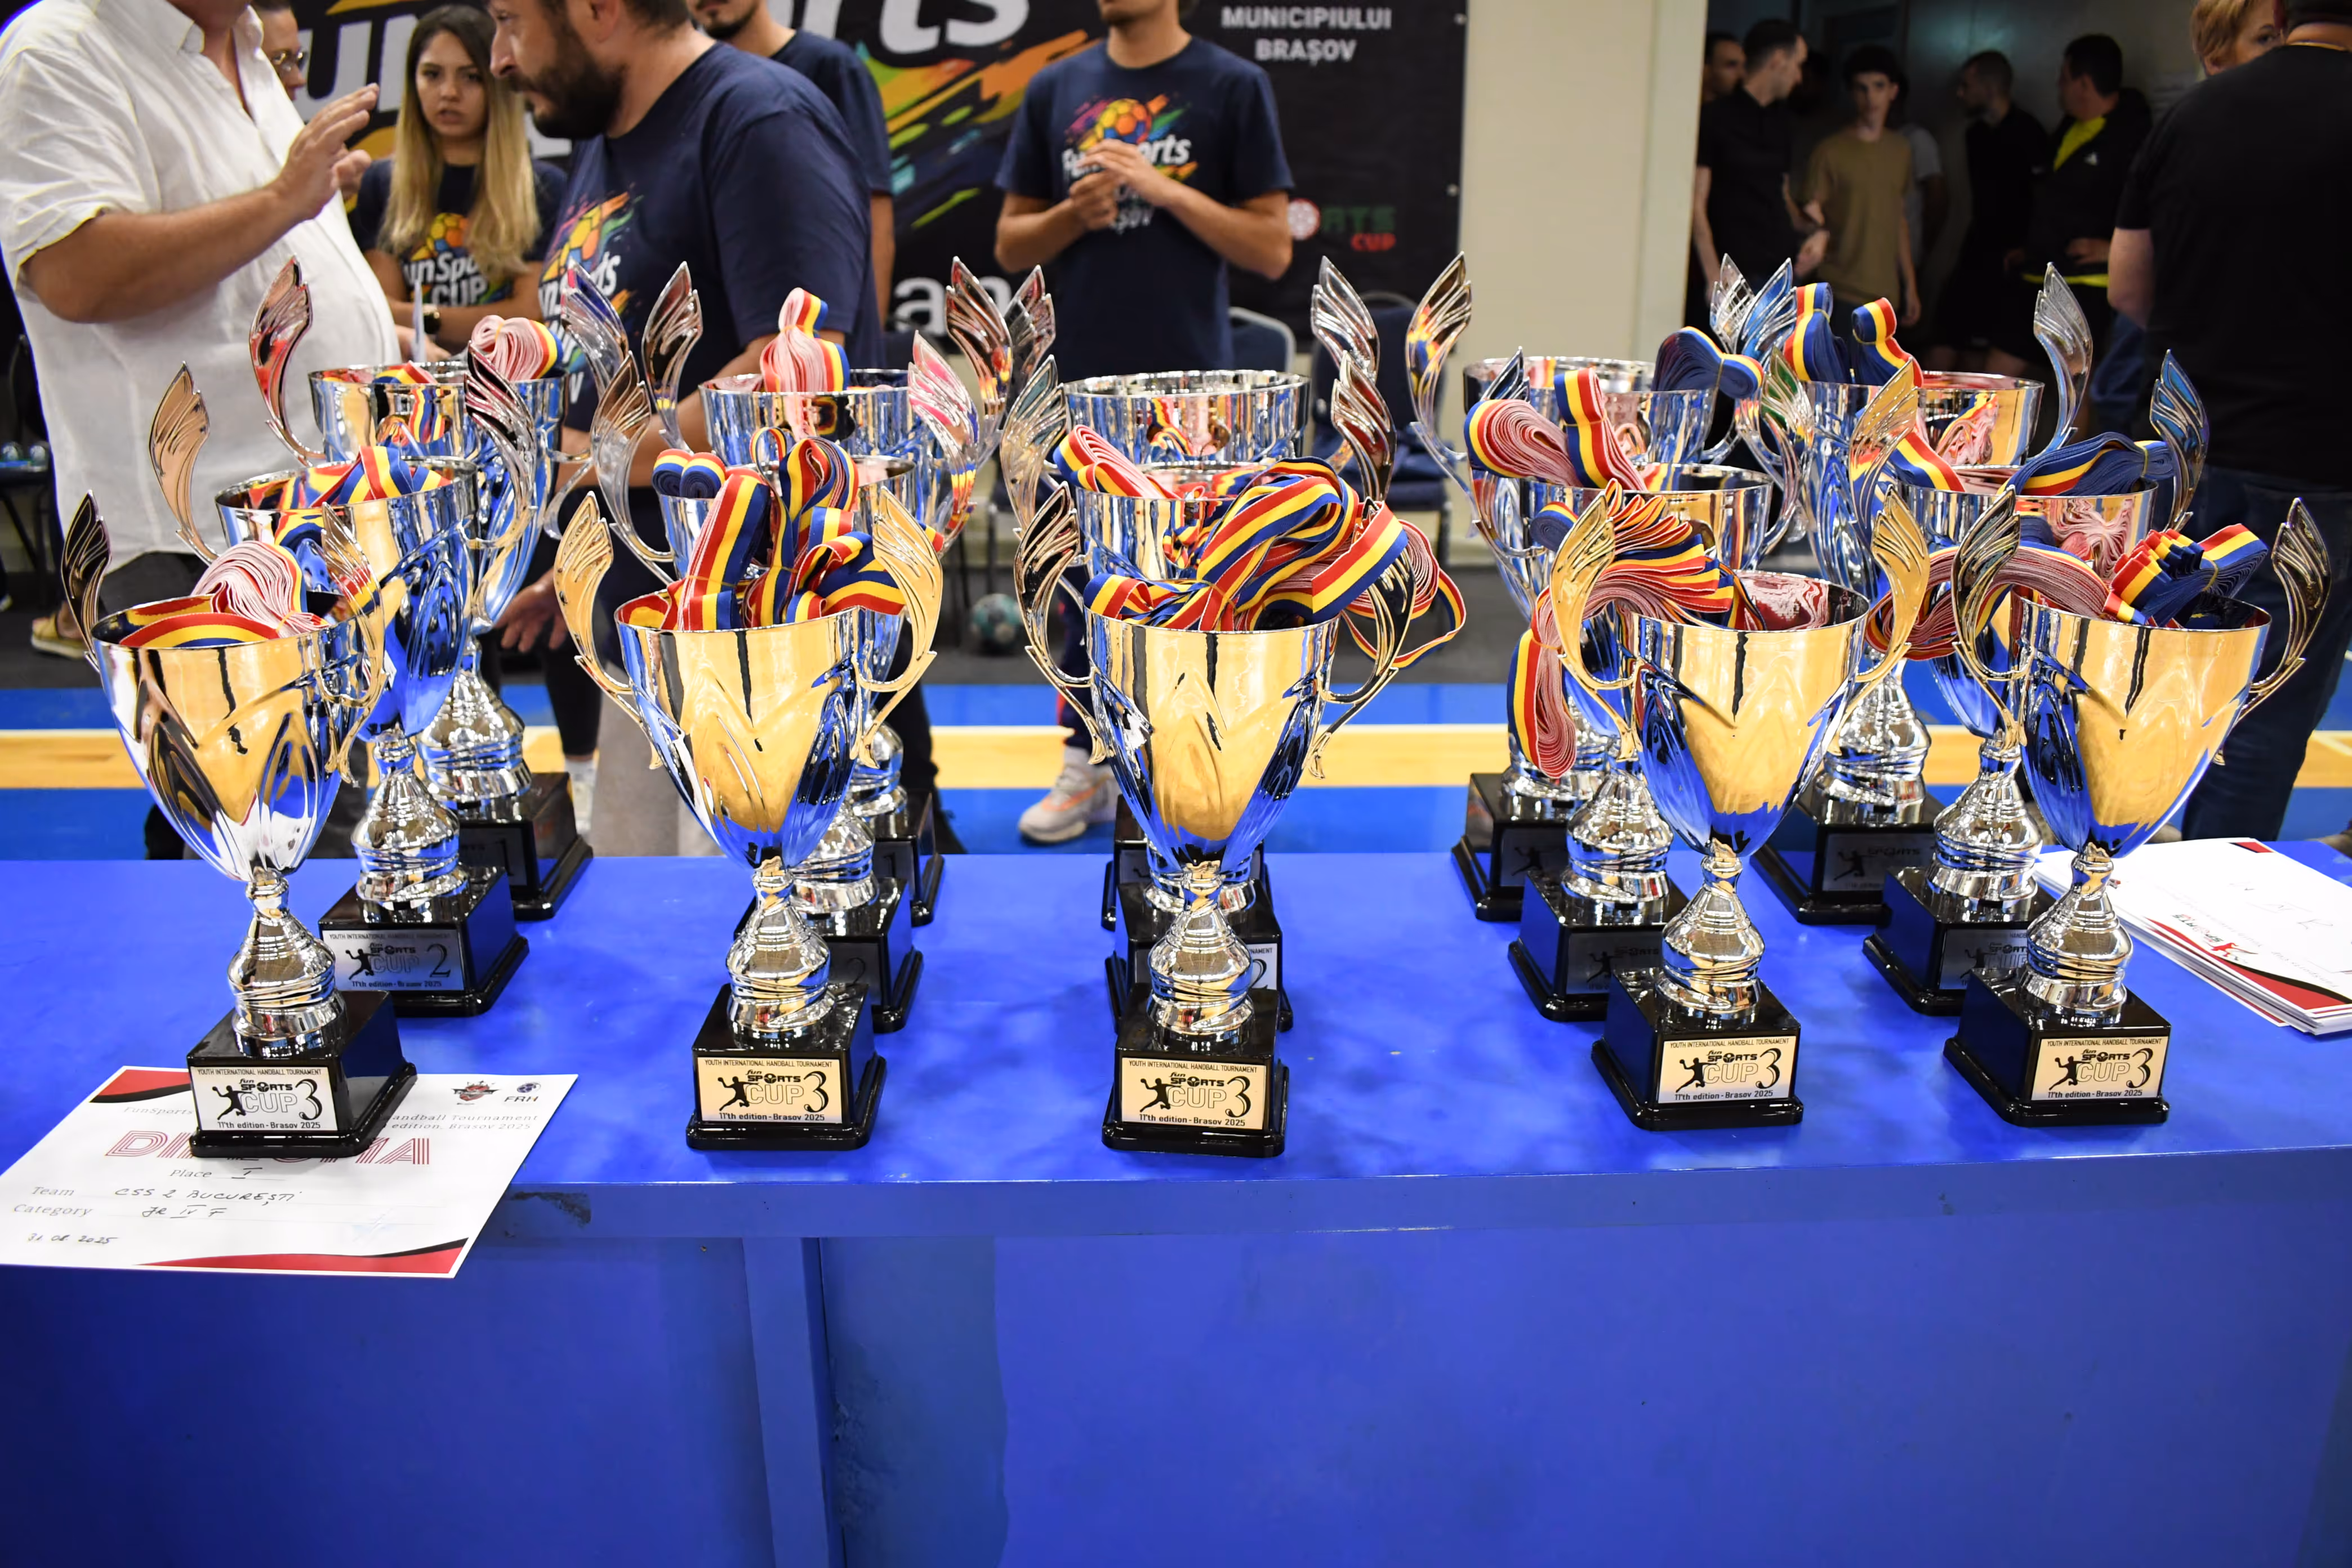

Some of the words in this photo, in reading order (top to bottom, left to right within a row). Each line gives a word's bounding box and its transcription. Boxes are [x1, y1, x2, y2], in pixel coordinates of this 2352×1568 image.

[1221, 6, 1392, 29] MUNICIPIULUI
[1351, 233, 1396, 251] CUP
[432, 274, 488, 307] CUP
[1990, 945, 2028, 954] SPORT
[369, 955, 420, 973] CUP
[426, 943, 451, 977] 2
[1708, 1053, 1758, 1063] SPORTS
[2082, 1052, 2131, 1062] SPORTS
[1147, 1061, 1189, 1070] INTERNATIONAL
[1703, 1063, 1758, 1084] CUP
[1756, 1048, 1781, 1089] 3
[2075, 1062, 2130, 1083] CUP
[2126, 1048, 2154, 1088] 3
[747, 1073, 801, 1084] SPORTS
[1170, 1076, 1224, 1087] SPORTS
[240, 1082, 293, 1092] SPORTS
[745, 1084, 804, 1104] CUP
[803, 1071, 829, 1112] 3
[239, 1093, 297, 1113] CUP
[295, 1079, 323, 1120] 3
[1168, 1086, 1227, 1108] CUP
[1225, 1076, 1251, 1117] 3
[1159, 1115, 1187, 1124] edition
[1193, 1117, 1222, 1125] Brasov
[170, 1169, 212, 1178] Place
[32, 1186, 75, 1196] Team
[115, 1188, 155, 1196] CSS
[14, 1204, 94, 1217] Category
